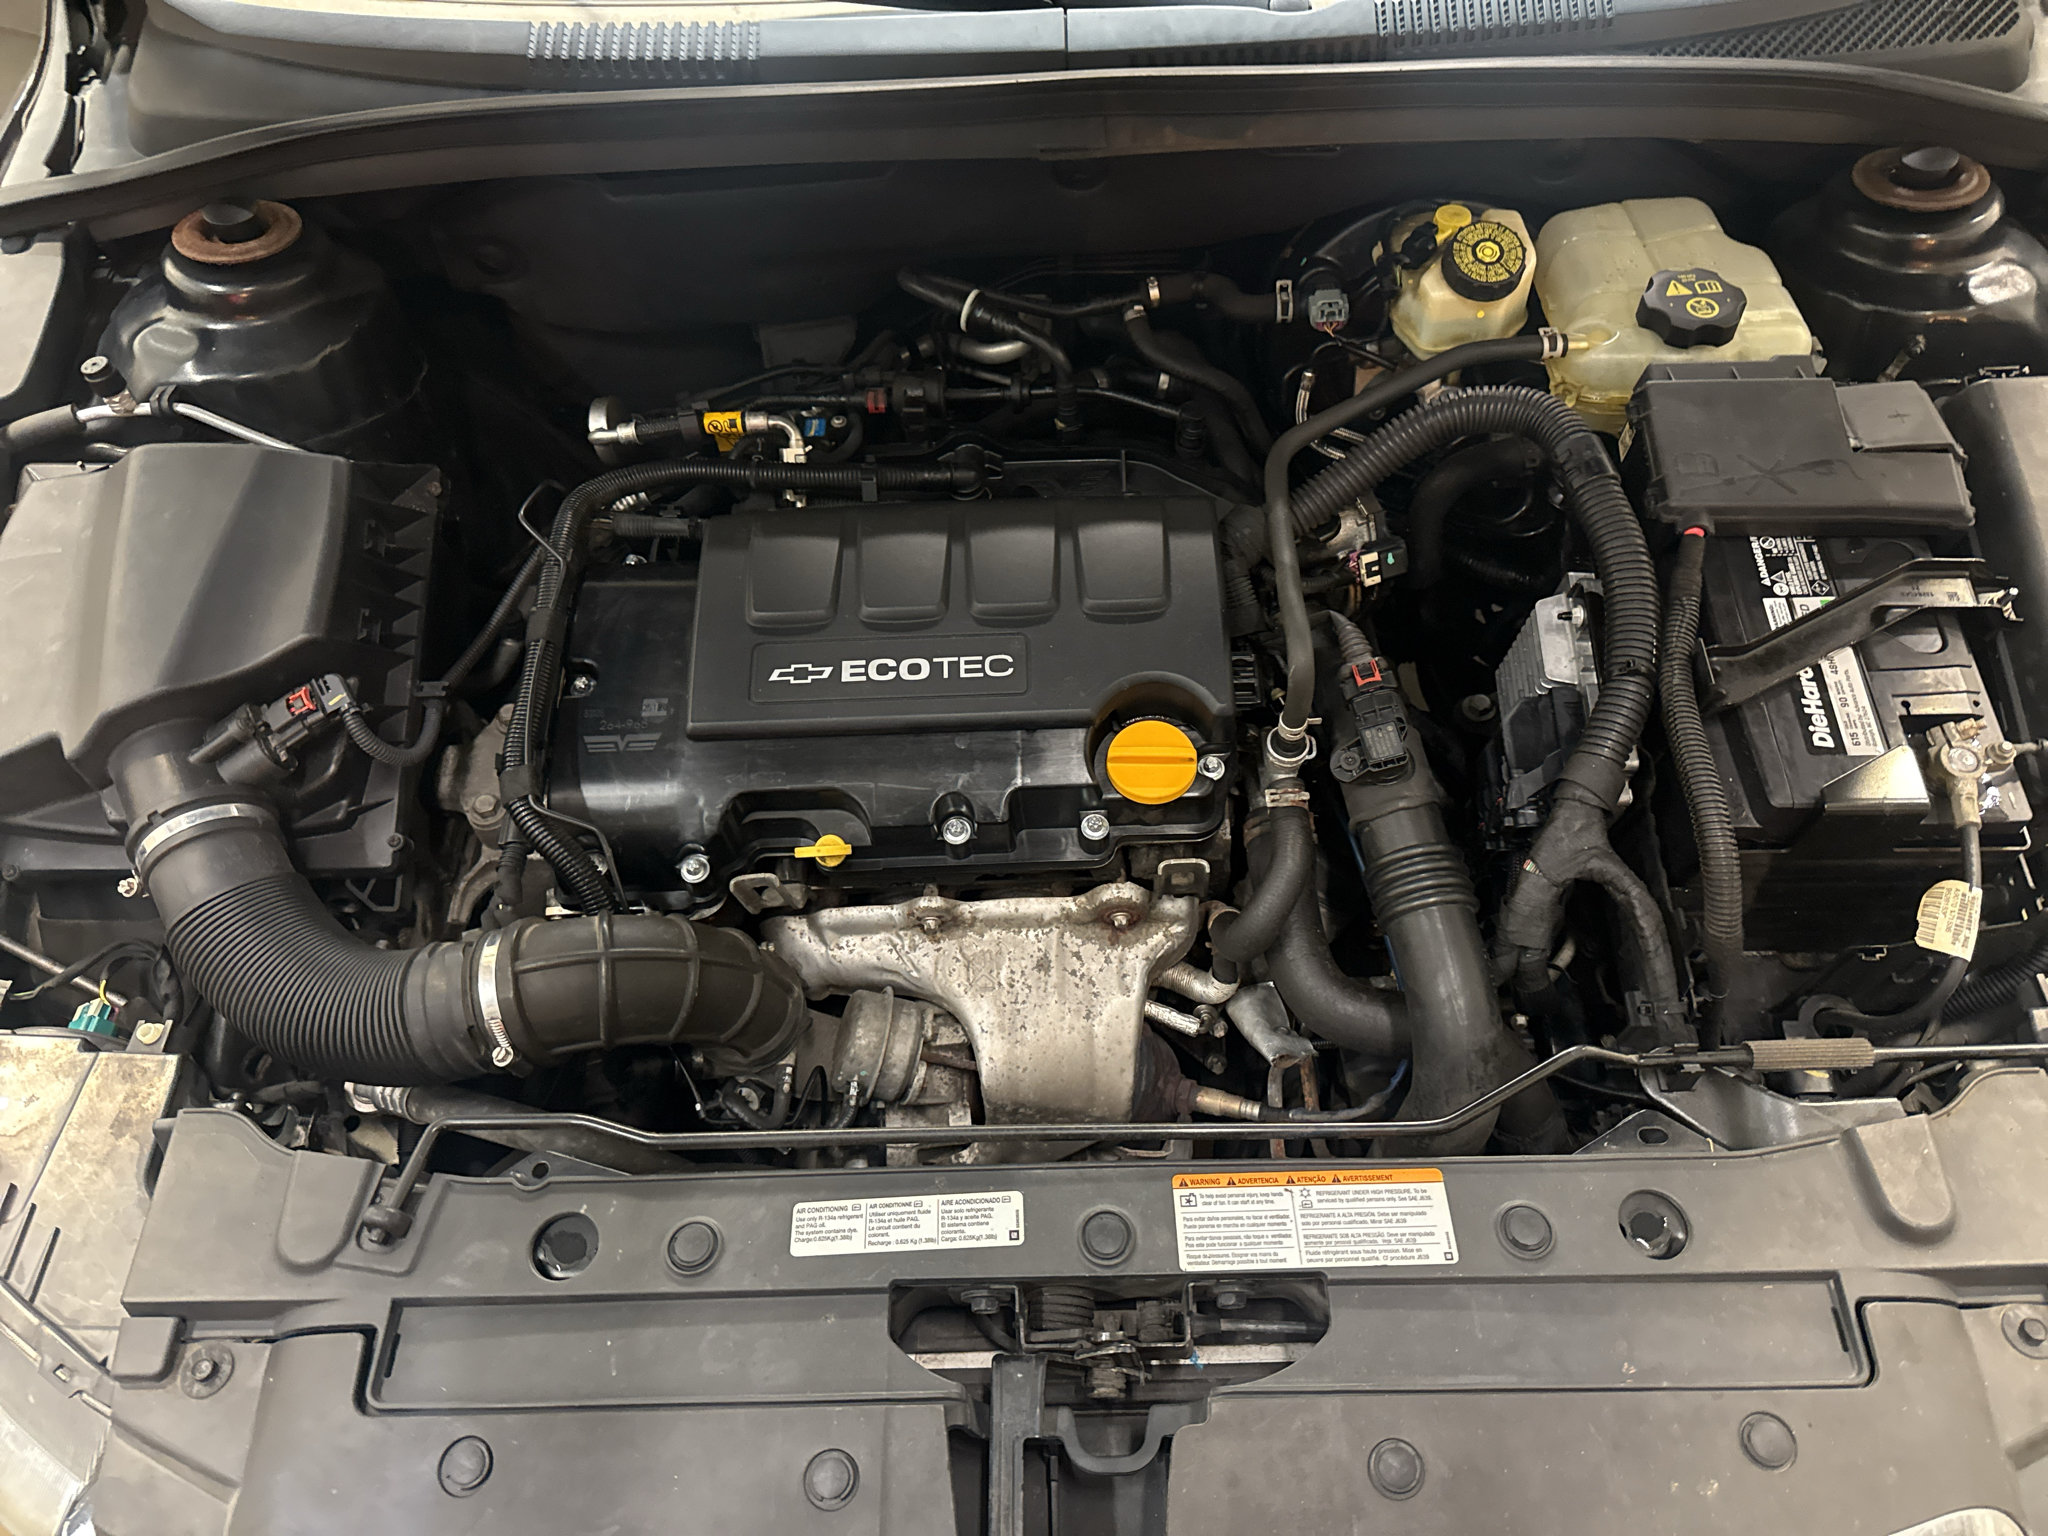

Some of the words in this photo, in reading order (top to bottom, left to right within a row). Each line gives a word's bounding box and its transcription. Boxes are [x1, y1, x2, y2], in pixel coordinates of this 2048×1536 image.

[1768, 604, 1780, 628] ARNING:
[841, 654, 1014, 682] ECOTEC
[1800, 666, 1835, 749] DieHard
[1839, 697, 1850, 708] 90
[1849, 732, 1861, 747] 615
[1189, 1178, 1221, 1186] WARNING
[1237, 1177, 1279, 1185] ADVERTENCIA
[1296, 1174, 1326, 1183] ATENÇÃO
[1343, 1174, 1393, 1182] AVERTISSEMENT
[955, 1197, 1000, 1205] ACONDICIONADO
[807, 1205, 848, 1213] CONDITIONING
